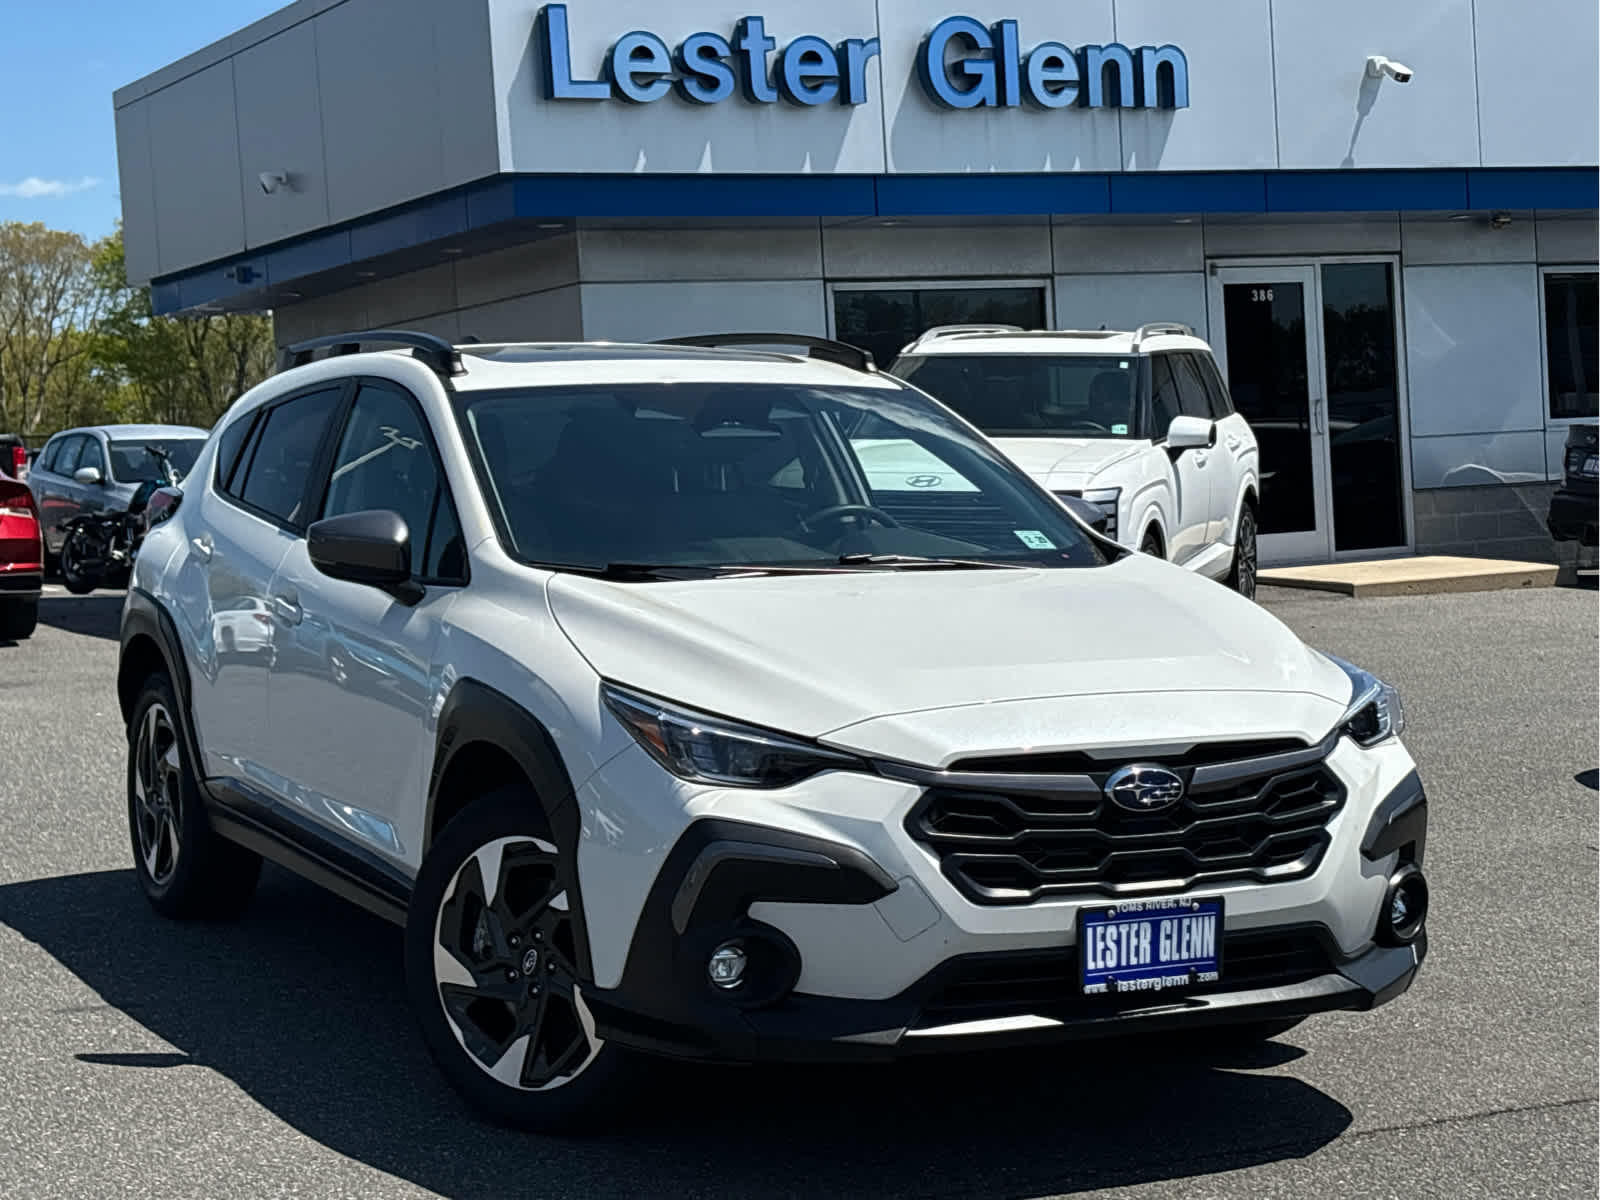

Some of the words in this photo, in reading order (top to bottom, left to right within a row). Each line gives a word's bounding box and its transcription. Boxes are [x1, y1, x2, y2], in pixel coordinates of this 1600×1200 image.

[537, 3, 881, 106] Lester
[915, 15, 1190, 110] Glenn
[1251, 288, 1274, 302] 386
[1116, 902, 1144, 913] TOMS
[1179, 896, 1192, 908] NJ
[1086, 921, 1152, 970] LESTER
[1158, 915, 1217, 963] GLENN
